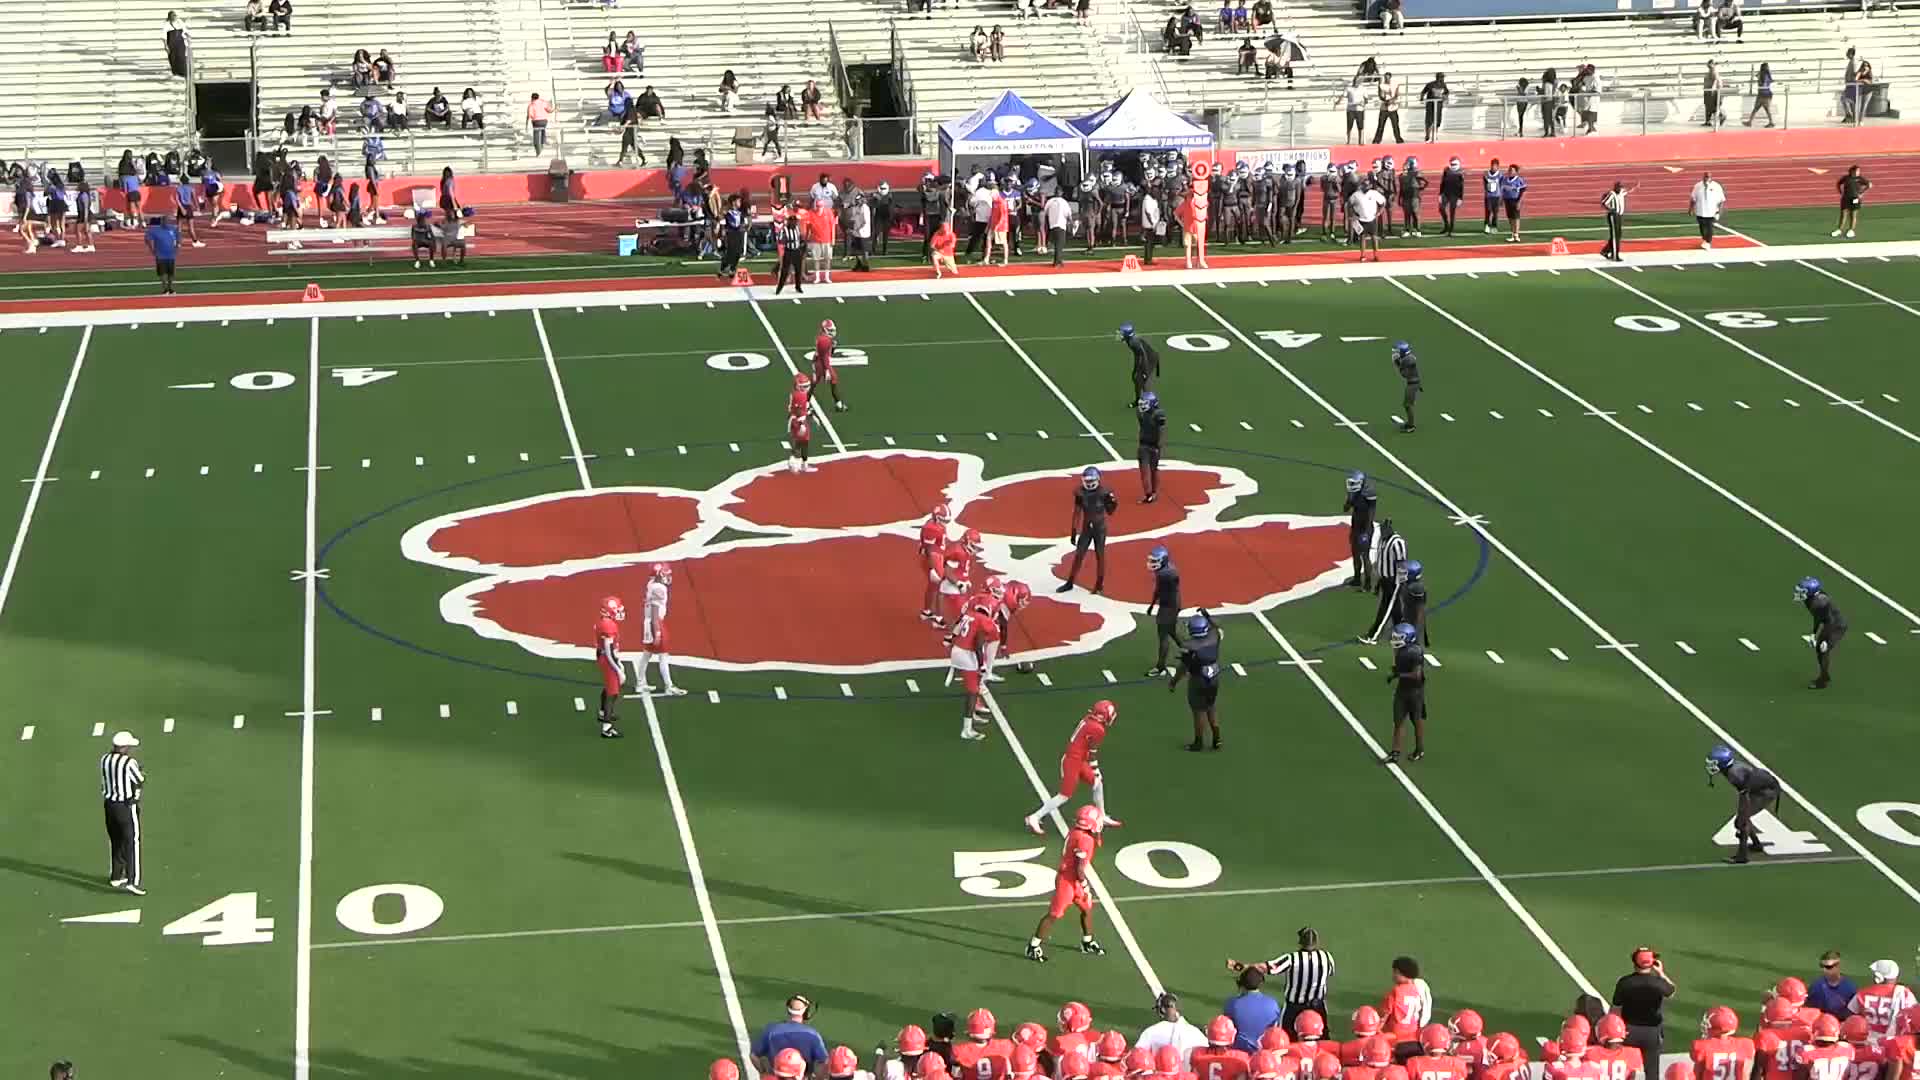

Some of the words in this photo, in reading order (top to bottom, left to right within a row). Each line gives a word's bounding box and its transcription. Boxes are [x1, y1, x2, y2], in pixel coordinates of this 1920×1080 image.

[737, 271, 748, 283] 50
[1864, 995, 1892, 1026] 55
[1712, 1052, 1737, 1080] 51
